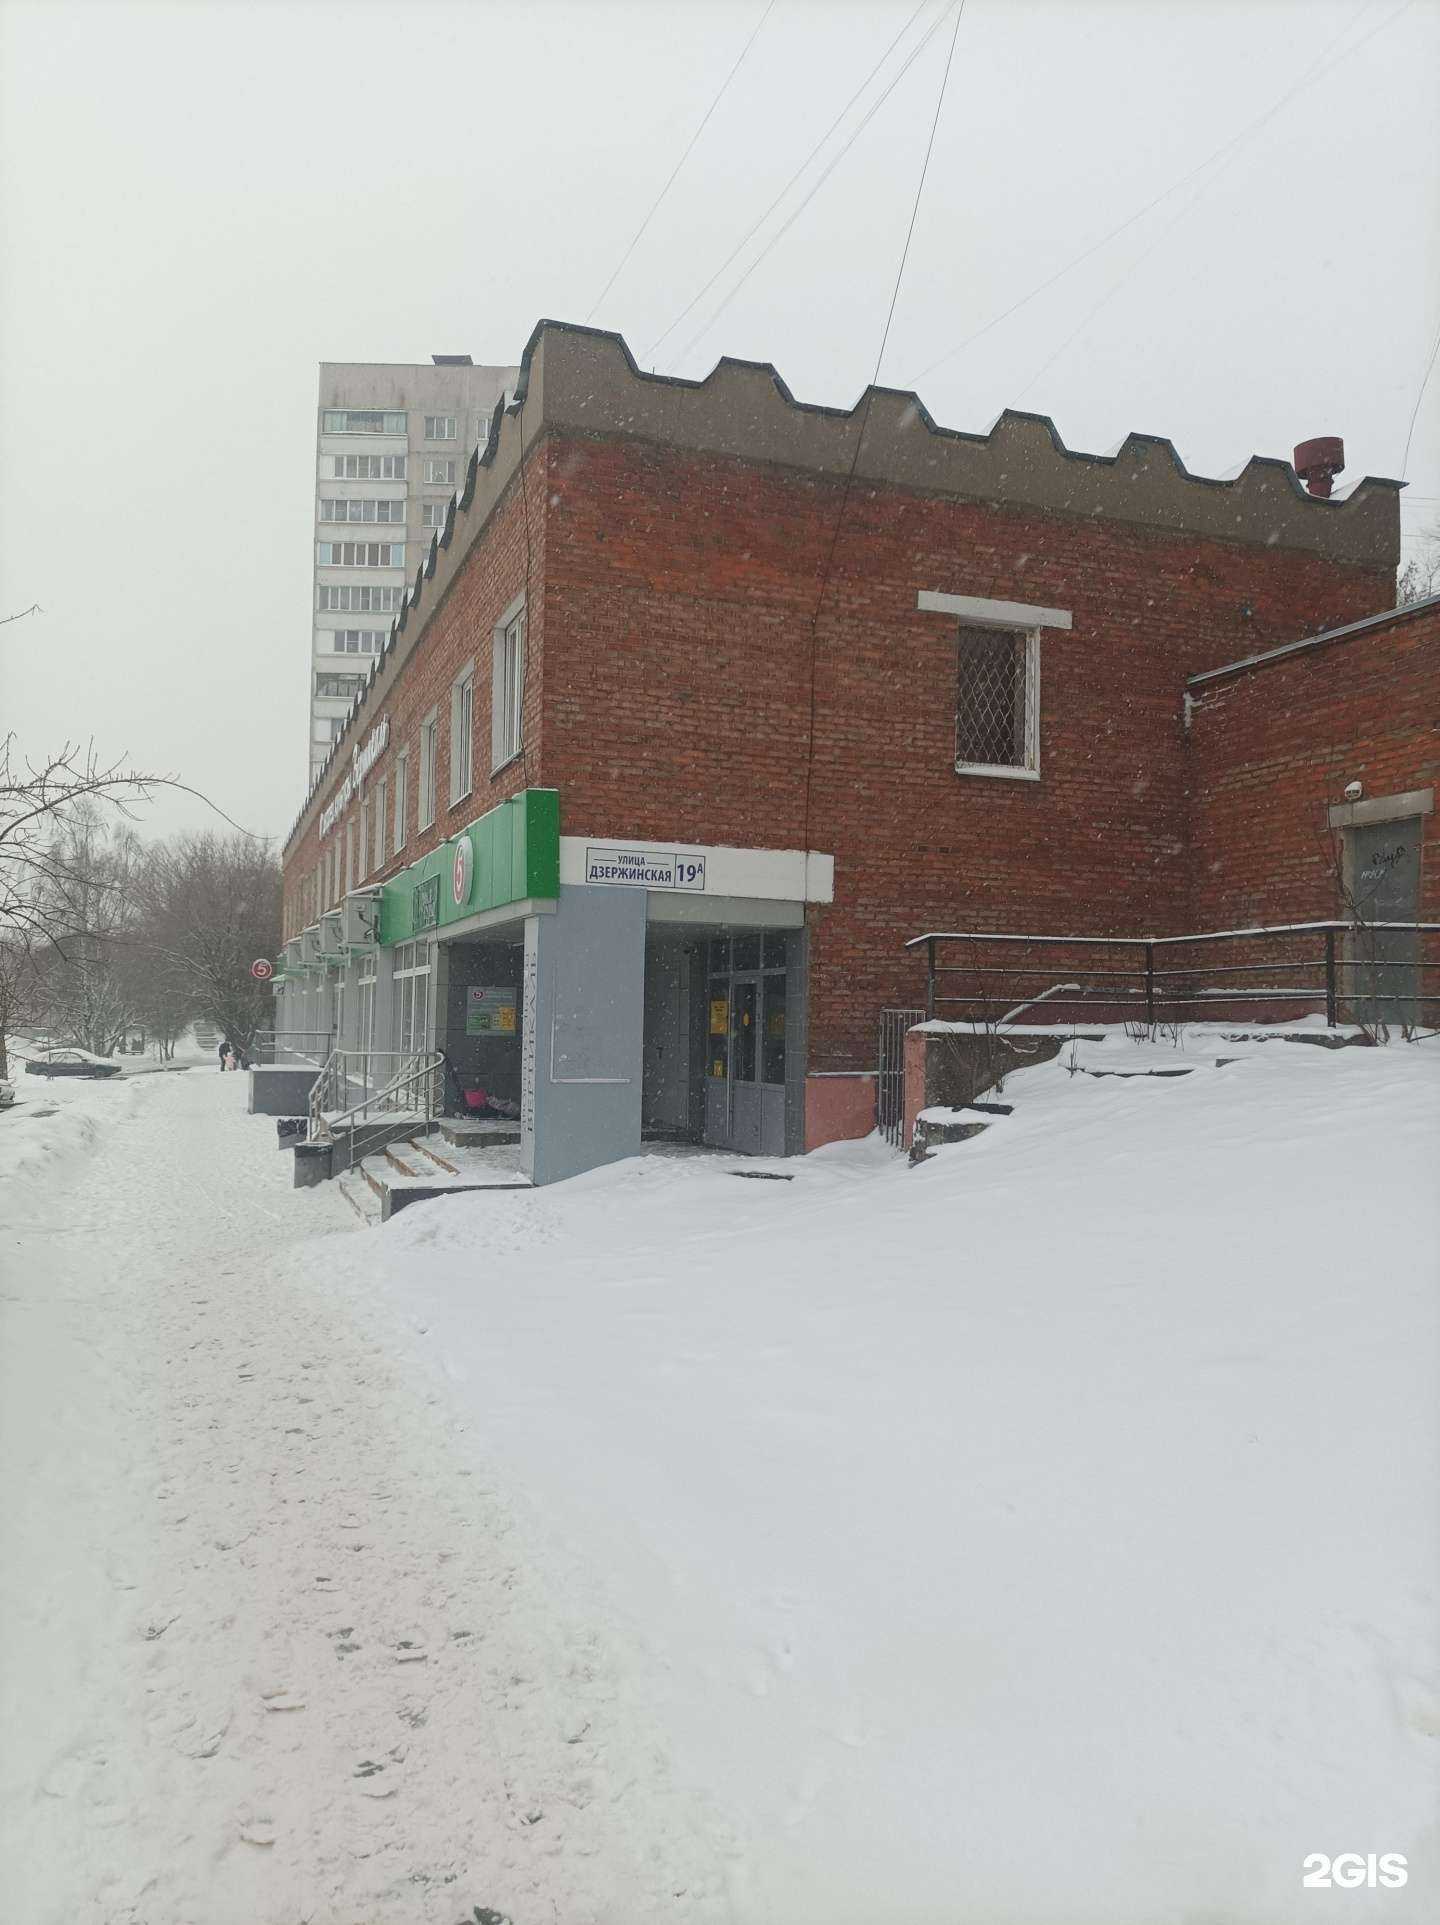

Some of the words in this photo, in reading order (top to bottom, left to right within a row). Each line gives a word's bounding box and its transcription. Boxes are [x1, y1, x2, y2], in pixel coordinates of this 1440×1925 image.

[618, 856, 646, 866] УЛИЦА
[590, 865, 671, 882] ДЗЕРЖИНСКАЯ
[677, 863, 704, 882] 19А
